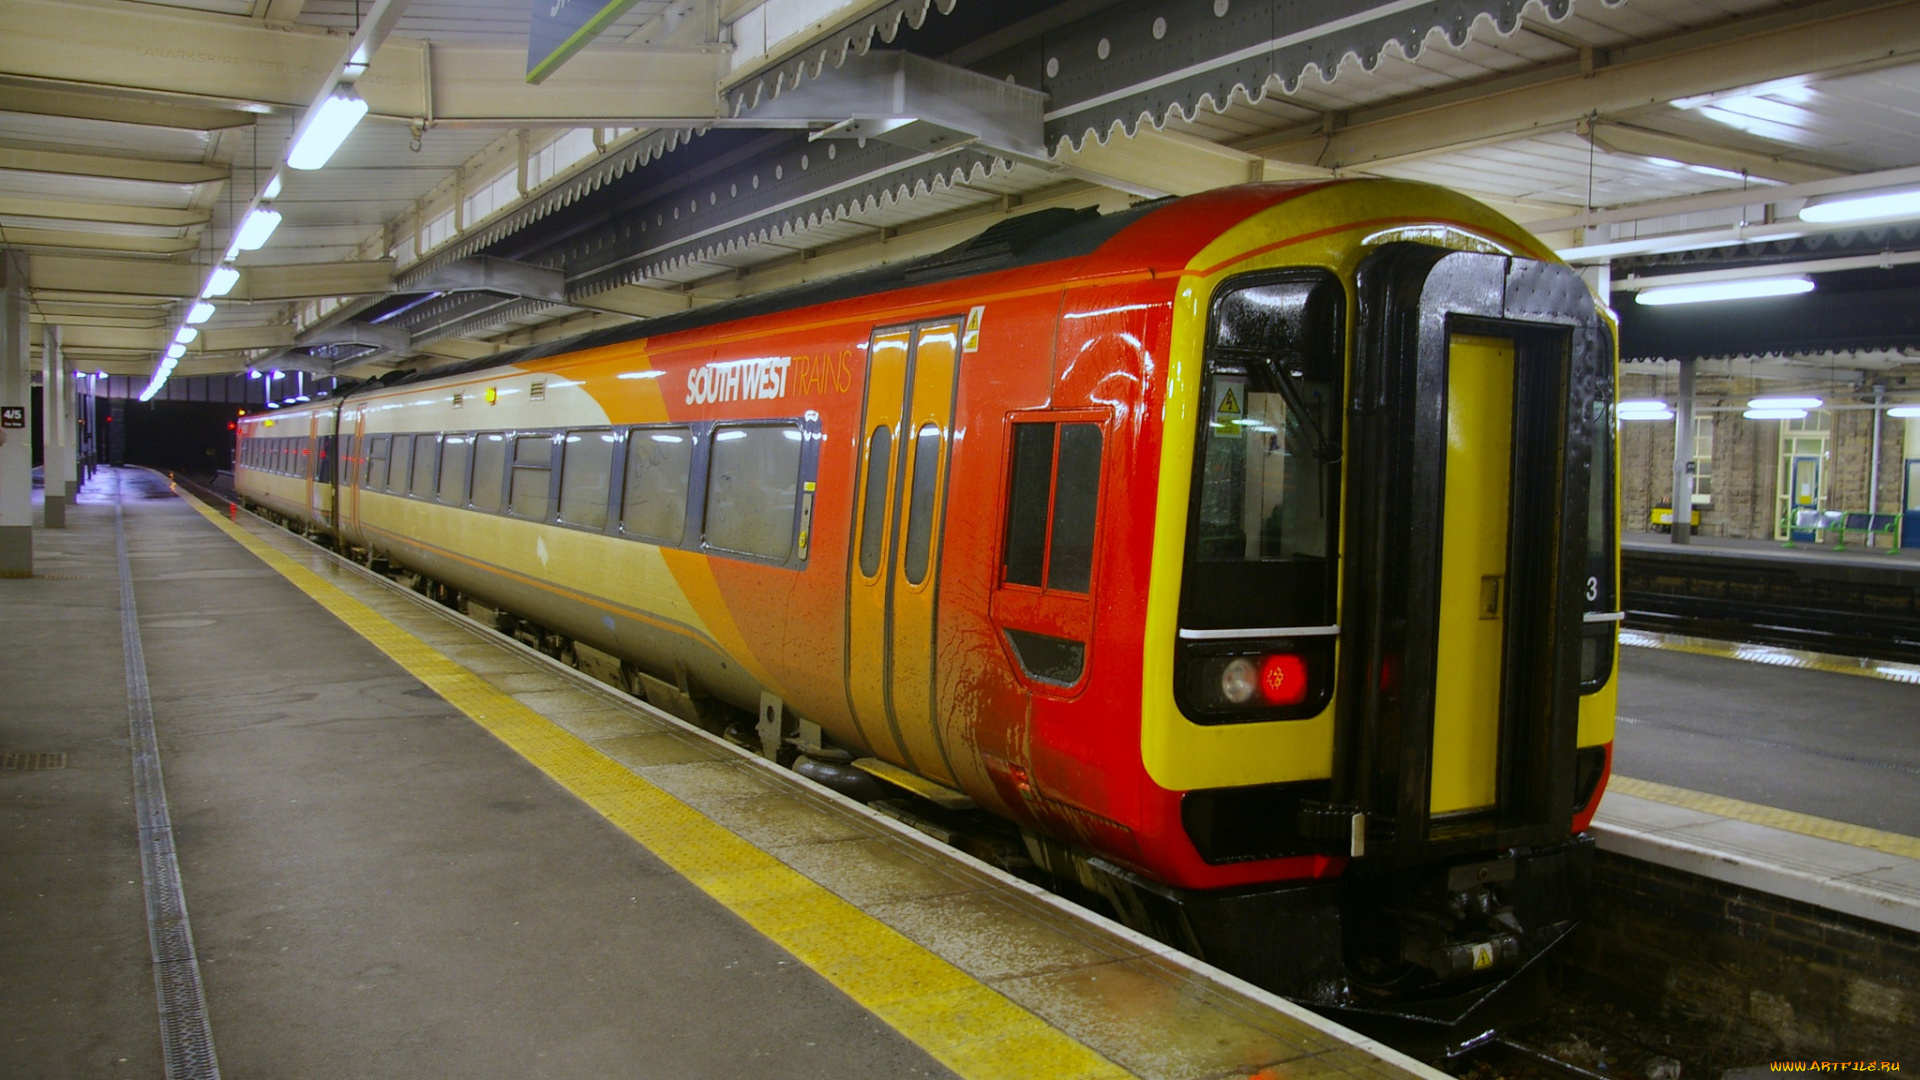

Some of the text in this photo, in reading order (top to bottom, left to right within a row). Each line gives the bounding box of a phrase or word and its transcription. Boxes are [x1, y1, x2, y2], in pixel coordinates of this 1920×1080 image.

[792, 350, 853, 397] TRAINS
[3, 409, 22, 420] 4/5
[1586, 575, 1598, 602] 3
